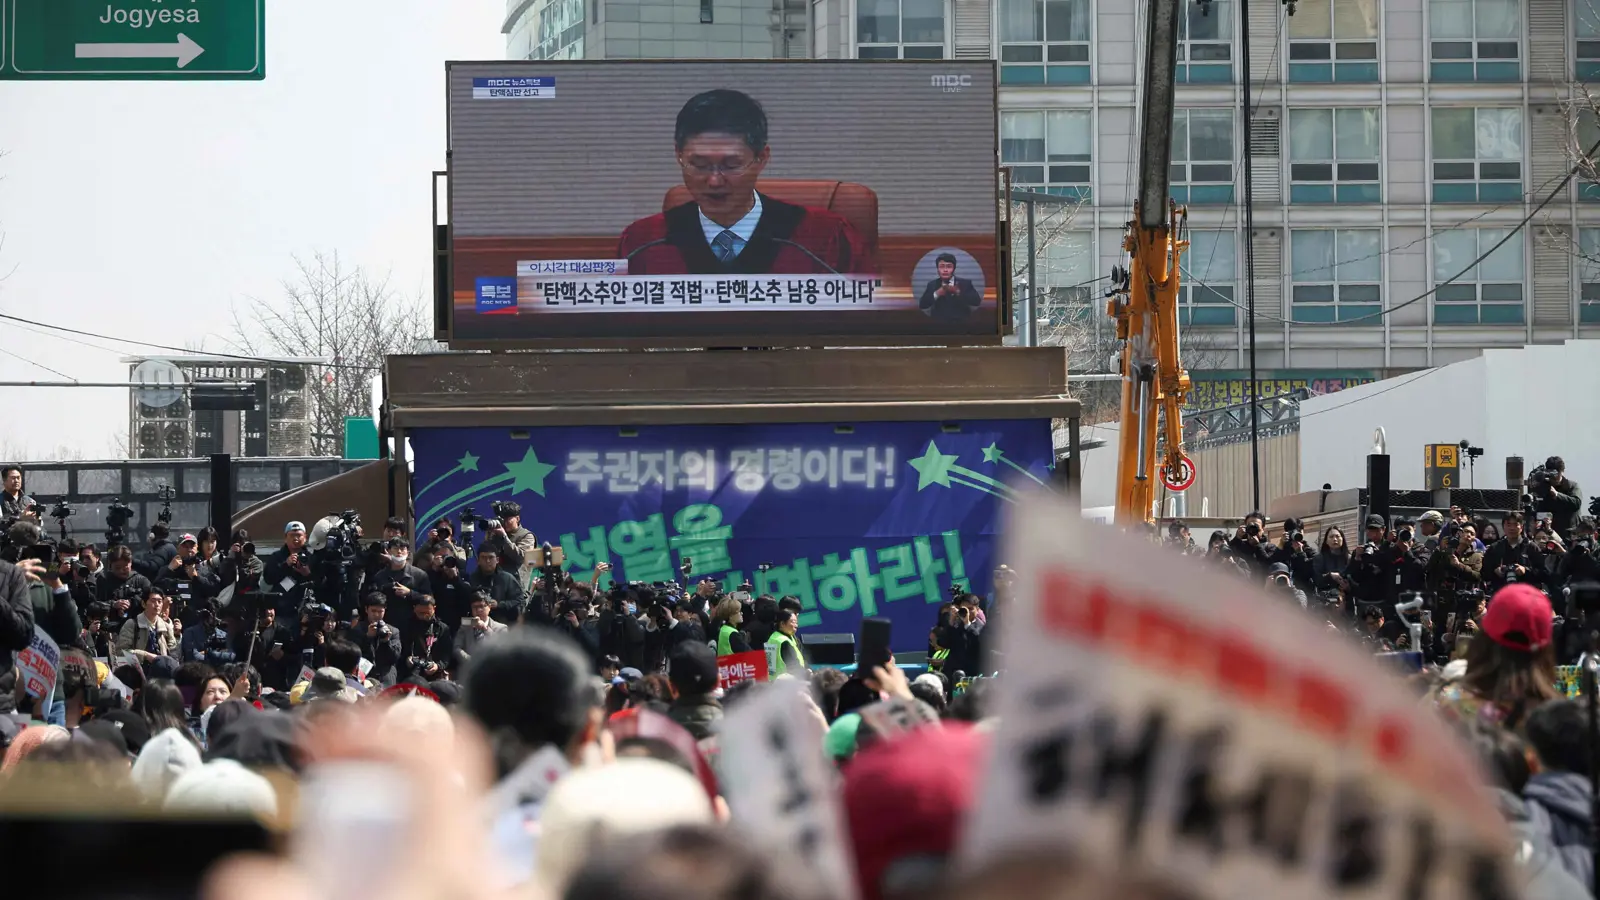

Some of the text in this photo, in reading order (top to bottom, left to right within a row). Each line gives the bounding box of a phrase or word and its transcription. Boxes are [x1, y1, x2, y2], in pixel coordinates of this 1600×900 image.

[99, 5, 200, 28] Jogyesa
[931, 74, 972, 87] MBC
[523, 88, 540, 97] 선고
[529, 261, 616, 274] 이 시각 대심판정
[481, 285, 511, 299] 특보
[631, 280, 665, 305] 의결
[787, 278, 820, 305] 남용
[564, 447, 896, 493] 주권자의 명령이다!
[1442, 473, 1452, 487] 6
[688, 529, 971, 628] 면하라!
